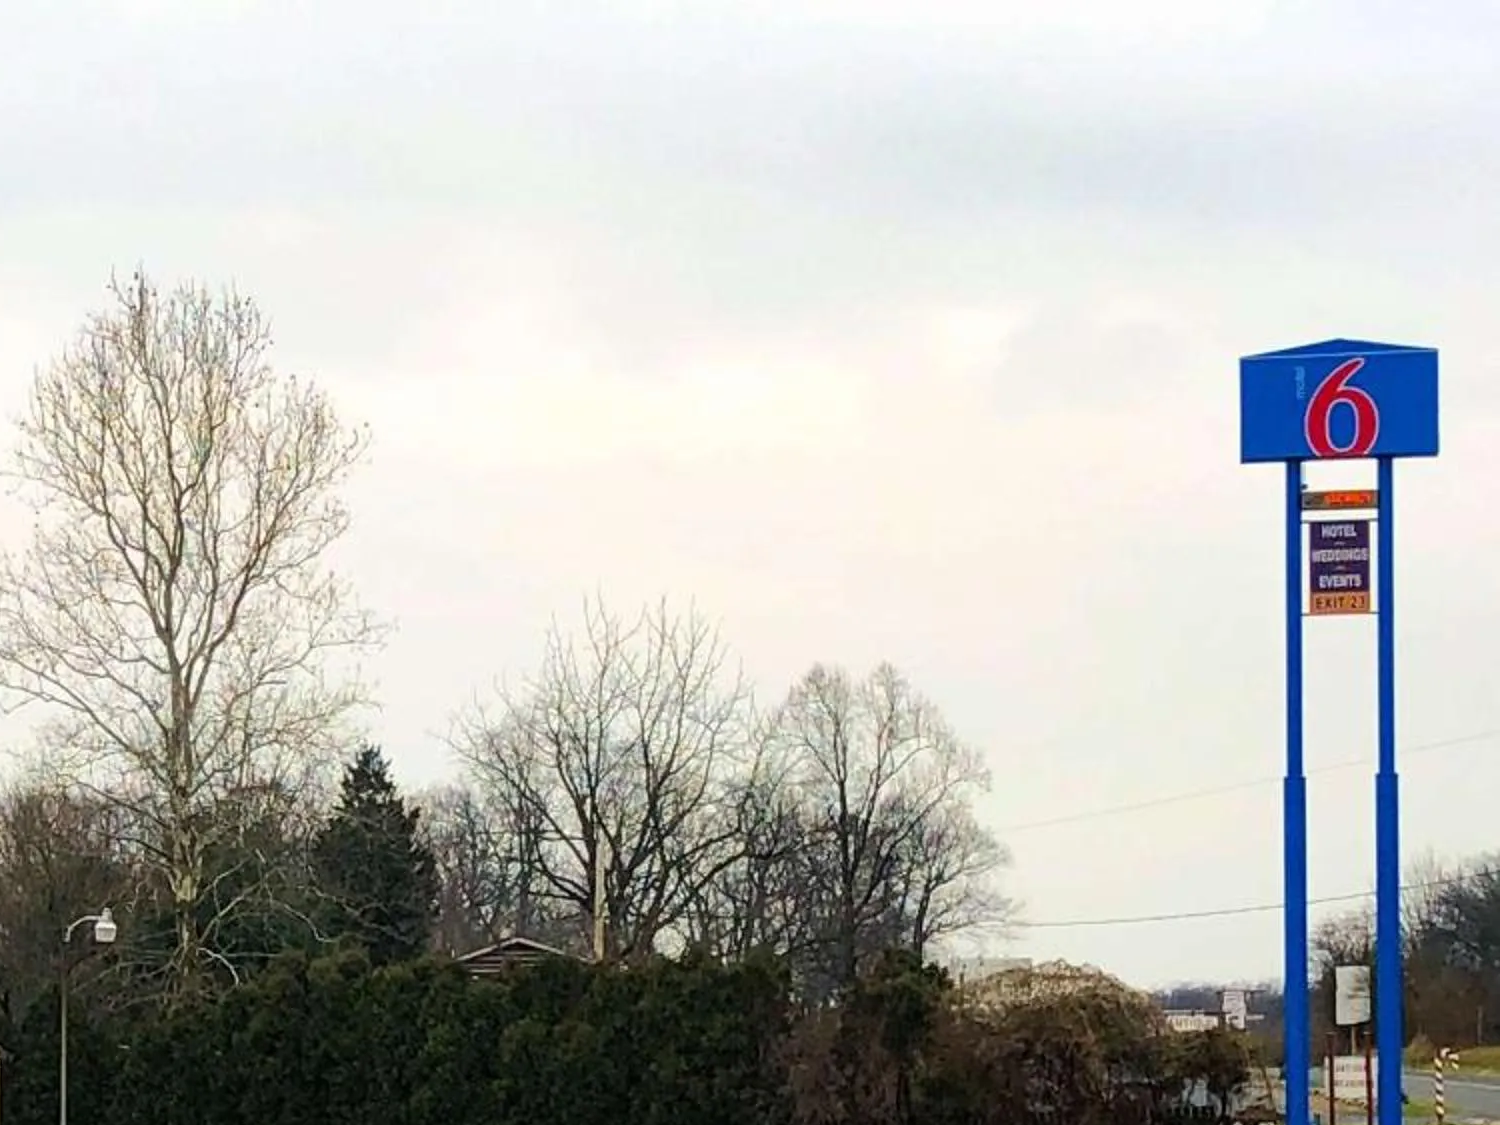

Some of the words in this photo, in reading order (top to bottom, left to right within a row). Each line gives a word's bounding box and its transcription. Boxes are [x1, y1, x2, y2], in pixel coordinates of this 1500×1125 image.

[1304, 357, 1380, 458] 6
[1321, 523, 1357, 538] HOTEL
[1318, 573, 1362, 589] EVENTS
[1315, 597, 1346, 609] EXIT
